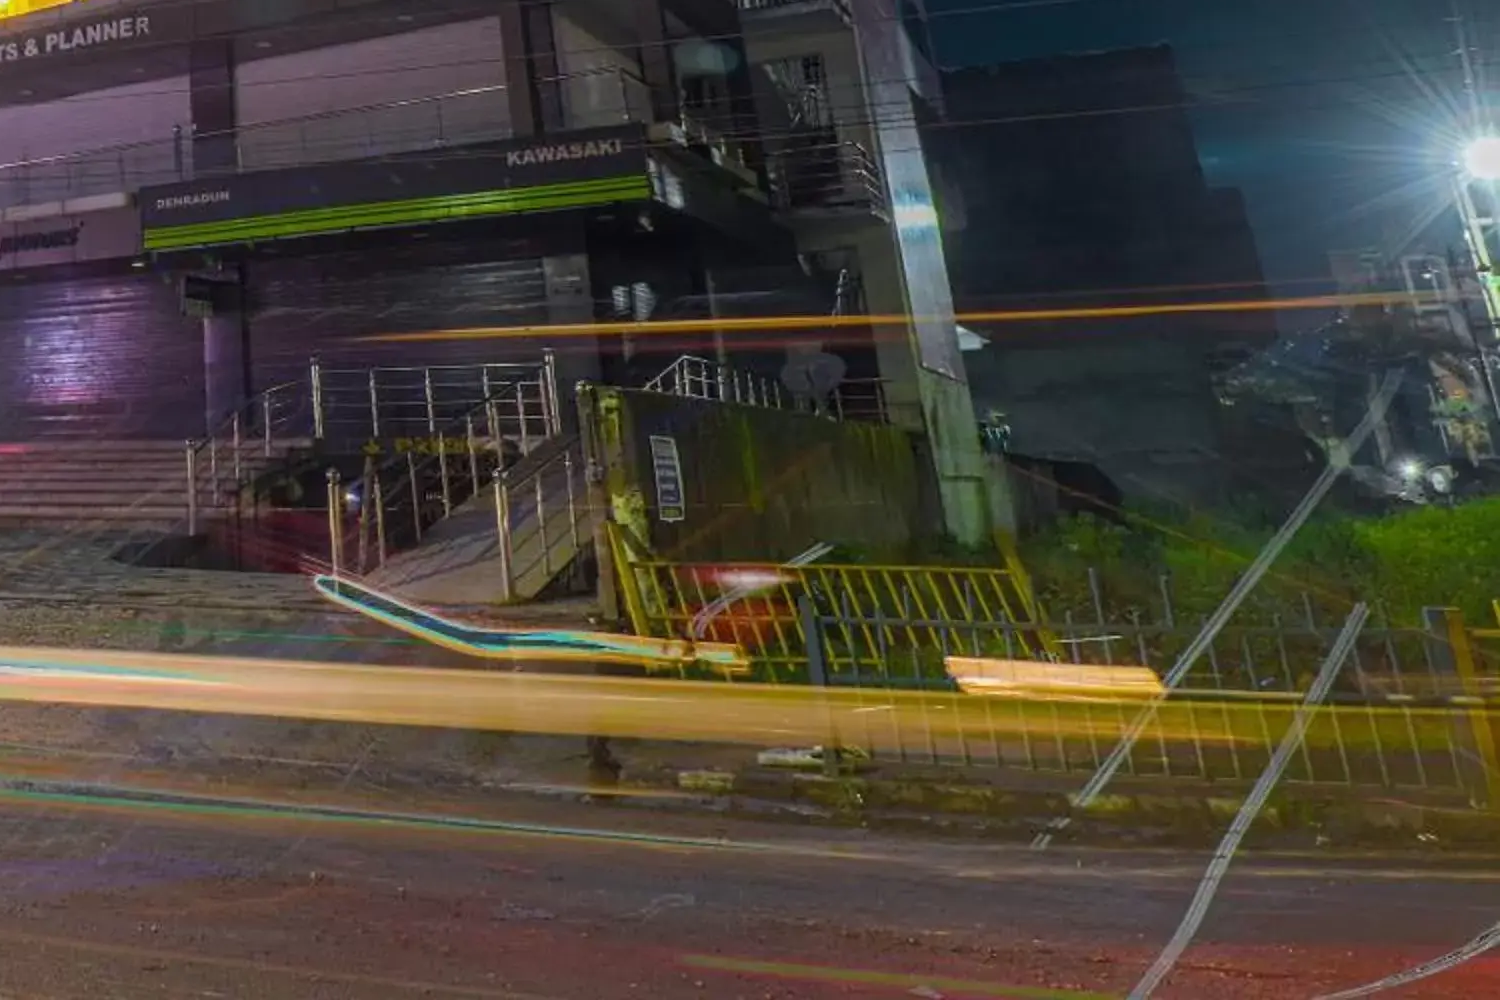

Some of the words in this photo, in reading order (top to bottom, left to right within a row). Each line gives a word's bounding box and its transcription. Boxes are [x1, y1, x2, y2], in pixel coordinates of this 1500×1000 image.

[23, 38, 39, 58] &
[45, 16, 150, 53] PLANNER
[506, 138, 624, 168] KAWASAKI
